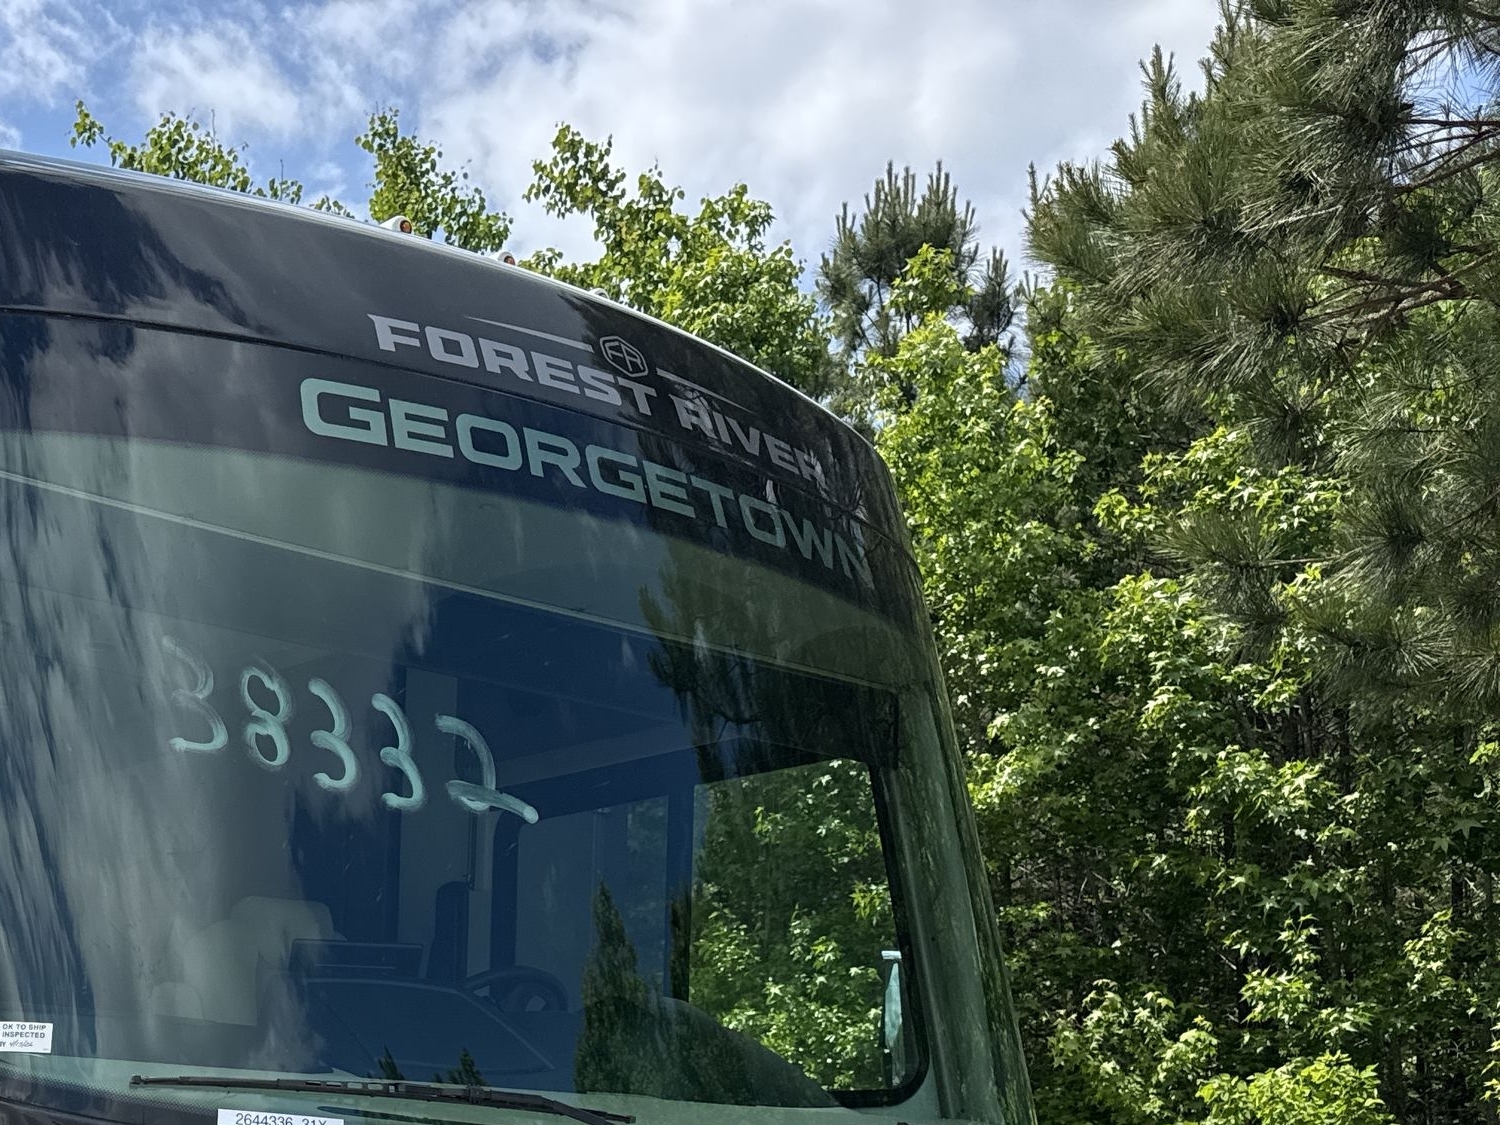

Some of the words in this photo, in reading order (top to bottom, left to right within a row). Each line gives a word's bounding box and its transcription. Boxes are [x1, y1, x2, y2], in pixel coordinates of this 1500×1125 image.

[299, 377, 876, 590] GEORGETOWN
[367, 314, 657, 416] FOREST
[668, 393, 828, 490] RIVER
[161, 634, 541, 825] 38332
[16, 1023, 27, 1031] TO
